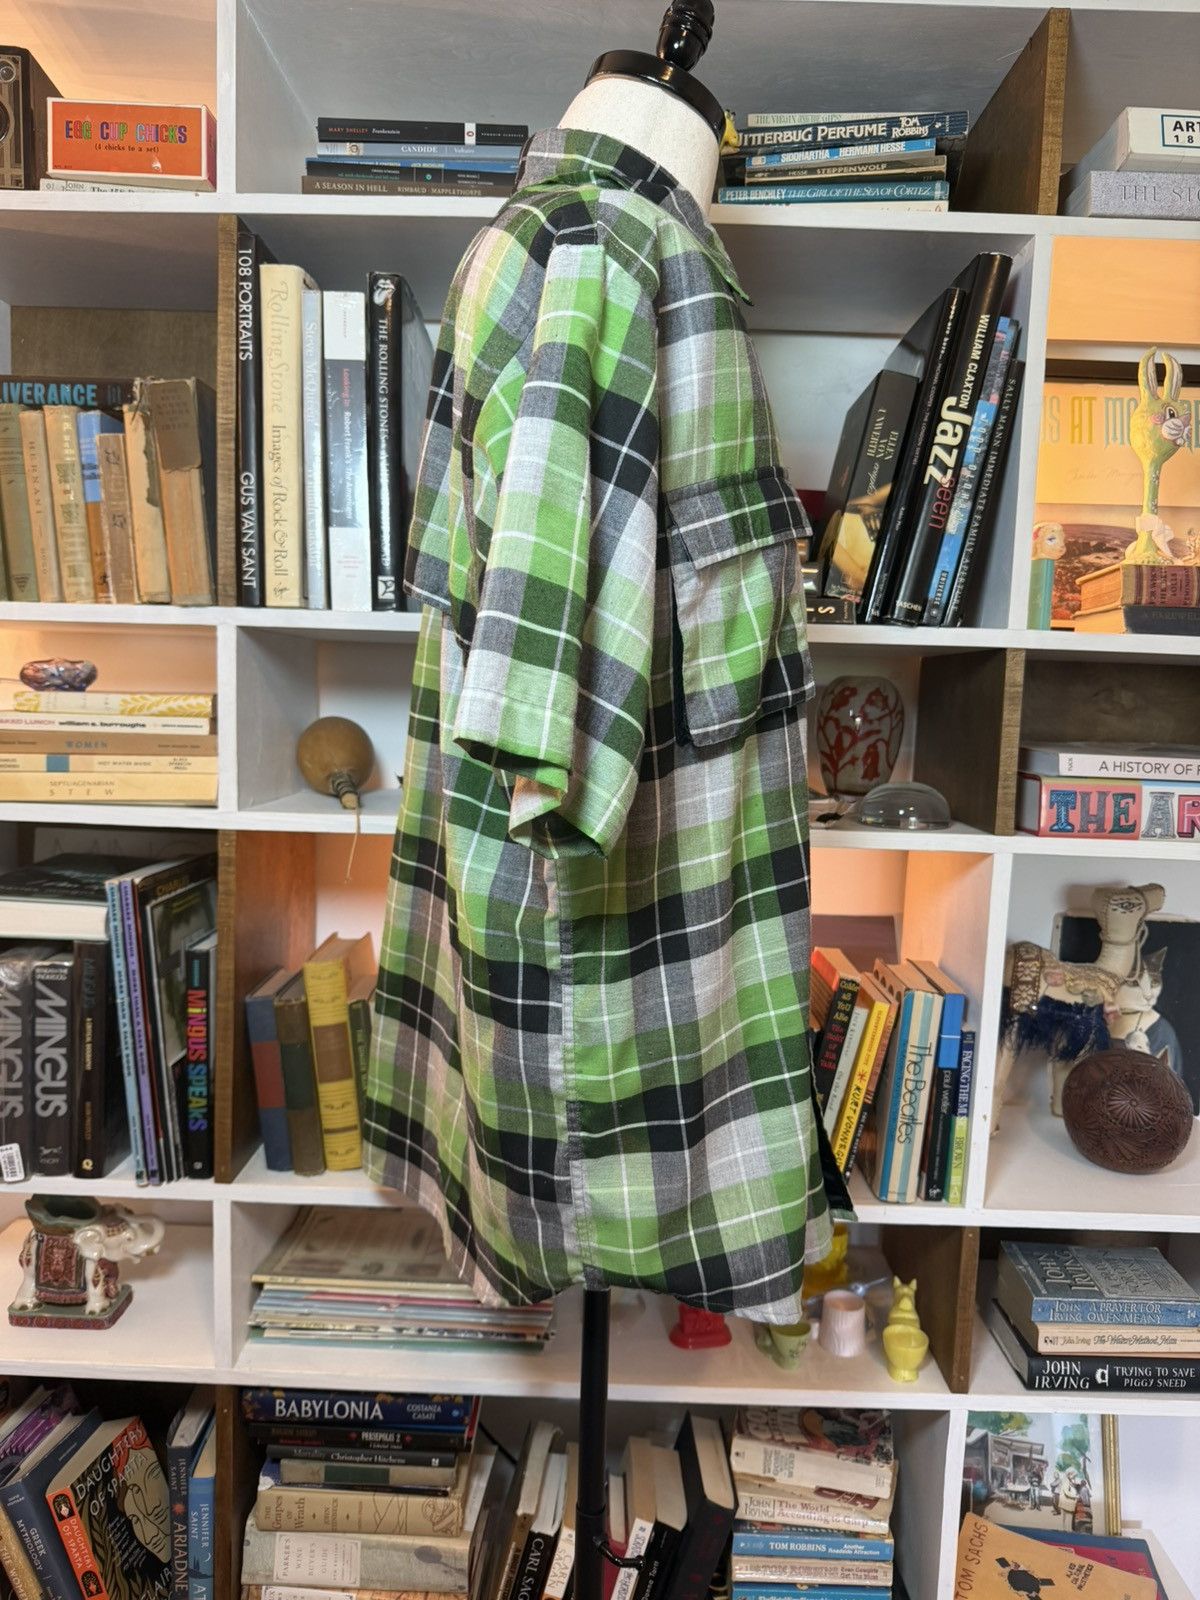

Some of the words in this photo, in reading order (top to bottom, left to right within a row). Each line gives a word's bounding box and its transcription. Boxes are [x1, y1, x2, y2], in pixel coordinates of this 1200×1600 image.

[65, 120, 92, 140] EGG
[100, 121, 128, 141] CUP
[135, 123, 187, 144] CHICKS
[816, 122, 888, 141] PERFUME
[891, 125, 929, 139] ROBBINS
[900, 116, 920, 128] TOM
[401, 145, 438, 153] CANDIDE
[781, 149, 830, 163] SIDDHARTHA
[839, 143, 879, 156] HERMANN
[880, 141, 906, 153] HESSE
[816, 163, 888, 175] STEPPENWOLF
[322, 182, 353, 191] SEASON
[726, 189, 749, 201] PETER
[749, 188, 786, 200] BENCHLEY
[893, 184, 931, 198] CORTEZ
[238, 249, 253, 277] 108
[238, 281, 253, 361] PORTRAITS
[268, 280, 290, 364] Rolling
[378, 320, 389, 341] THE
[970, 314, 991, 361] WILLIAM
[378, 343, 389, 395] ROLLING
[271, 362, 290, 414] Stone
[959, 362, 979, 410] CLAXTON
[1002, 378, 1016, 412] SALLY
[379, 397, 391, 441] STONES
[866, 408, 887, 458] UNWERTH
[992, 414, 1008, 448] MANN
[1070, 396, 1097, 444] AT
[267, 424, 287, 474] Images
[876, 438, 889, 459] VON
[884, 431, 899, 461] ELLEN
[923, 396, 973, 488] Jazz
[28, 441, 41, 515] HERNANI
[239, 472, 256, 507] GUS
[270, 474, 288, 492] of
[975, 450, 998, 512] IMMEDIATE
[272, 489, 288, 527] Rock
[928, 476, 955, 530] seen
[241, 508, 257, 547] VAN
[964, 514, 982, 553] FAMILY
[241, 549, 258, 589] SANT
[273, 546, 289, 577] Roll
[896, 601, 922, 612] TASCHEN
[100, 721, 146, 729] burroughs
[65, 740, 108, 749] WOMEN
[1099, 761, 1109, 771] A
[1113, 761, 1170, 775] HISTORY
[1174, 763, 1193, 775] OF
[49, 780, 116, 788] SEPTUAGENARIAN
[1049, 789, 1137, 835] THE
[35, 981, 68, 1118] MINGUS
[906, 1042, 933, 1077] The
[942, 1070, 952, 1089] paul
[959, 1050, 973, 1081] FACING
[849, 1084, 862, 1114] KURT
[897, 1078, 926, 1144] Beatles
[940, 1089, 951, 1115] weller
[836, 1115, 854, 1167] VONNEGU
[1037, 1252, 1073, 1286] JOHN
[1050, 1309, 1082, 1321] IRVING
[1087, 1312, 1119, 1322] OWEN
[1123, 1313, 1163, 1324] MEANY
[1054, 1301, 1080, 1312] JOHN
[1100, 1303, 1135, 1312] PRAYER
[1137, 1304, 1162, 1313] FOR
[1035, 1376, 1090, 1389] IRVING
[1042, 1360, 1081, 1376] JOHN
[1114, 1365, 1152, 1378] TRYING
[1155, 1366, 1169, 1378] TO
[1172, 1367, 1196, 1378] SAVE
[1124, 1378, 1154, 1388] PIGGY
[1157, 1378, 1187, 1389] SNEED
[275, 1398, 384, 1421] BABYLONIA
[406, 1403, 442, 1413] COSTANZA
[361, 1431, 396, 1442] PERSEPOLIS
[75, 1426, 144, 1501] DAUGHTERS
[331, 1453, 372, 1464] Christopher
[373, 1455, 406, 1464] Hitchens
[90, 1492, 106, 1517] OF
[107, 1451, 149, 1499] SPARTA
[271, 1495, 285, 1529] Grapes
[294, 1497, 306, 1529] Wrath
[744, 1502, 774, 1518] IRVING
[750, 1497, 772, 1508] JOHN
[777, 1500, 798, 1510] The
[800, 1502, 830, 1513] World
[62, 1525, 73, 1537] OF
[191, 1511, 199, 1540] SAINT
[200, 1503, 210, 1549] JENNIFER
[777, 1510, 830, 1524] According
[843, 1514, 869, 1528] Garp
[16, 1519, 43, 1572] MYTHOLOGY
[29, 1527, 47, 1557] GREEK
[70, 1518, 94, 1569] DAUGHTERS
[174, 1521, 189, 1592] ARIADNE
[525, 1537, 545, 1574] CARL
[769, 1542, 788, 1551] TOM
[789, 1543, 827, 1552] ROBBINS
[966, 1521, 989, 1566] SACHS
[547, 1548, 566, 1589] SAGAN
[557, 1554, 573, 1587] CARL
[954, 1567, 975, 1600] TOM
